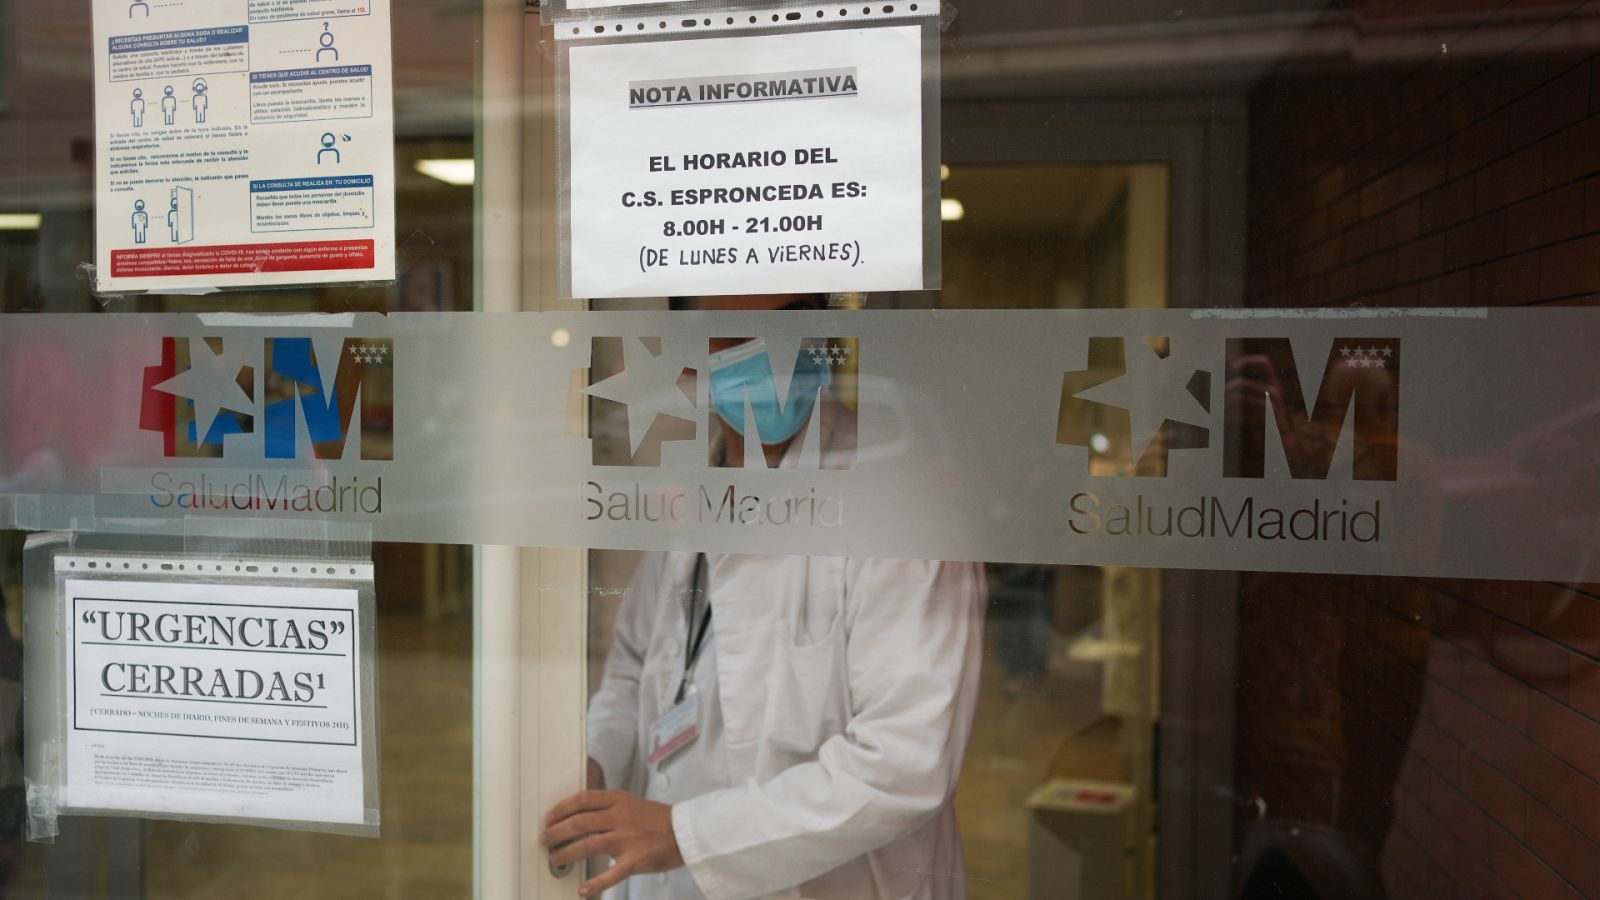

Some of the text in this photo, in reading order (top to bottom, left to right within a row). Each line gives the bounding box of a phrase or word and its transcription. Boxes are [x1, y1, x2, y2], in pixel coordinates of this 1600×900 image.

[143, 34, 172, 42] PREGUNTAR
[216, 27, 243, 35] REALIZAR
[630, 75, 858, 104] NOTA INFORMATIVA
[649, 147, 838, 172] EL HORARIO DEL
[621, 181, 867, 207] C.S. ESPRONCEDA ES:
[663, 219, 725, 236] 8.00H
[745, 214, 823, 234] 21.00H
[639, 245, 669, 272] (DE
[679, 247, 738, 266] LUNES
[745, 251, 759, 264] A
[150, 472, 382, 514] SaludMadrid
[1068, 491, 1380, 542] SaludMadrid
[138, 710, 169, 719] NOCHES
[170, 711, 181, 719] DE
[183, 712, 213, 722] DIARIO,
[214, 714, 237, 723] FINES
[238, 715, 249, 724] DE
[250, 717, 283, 726] SEMANA
[291, 719, 331, 729] FESTIVOS
